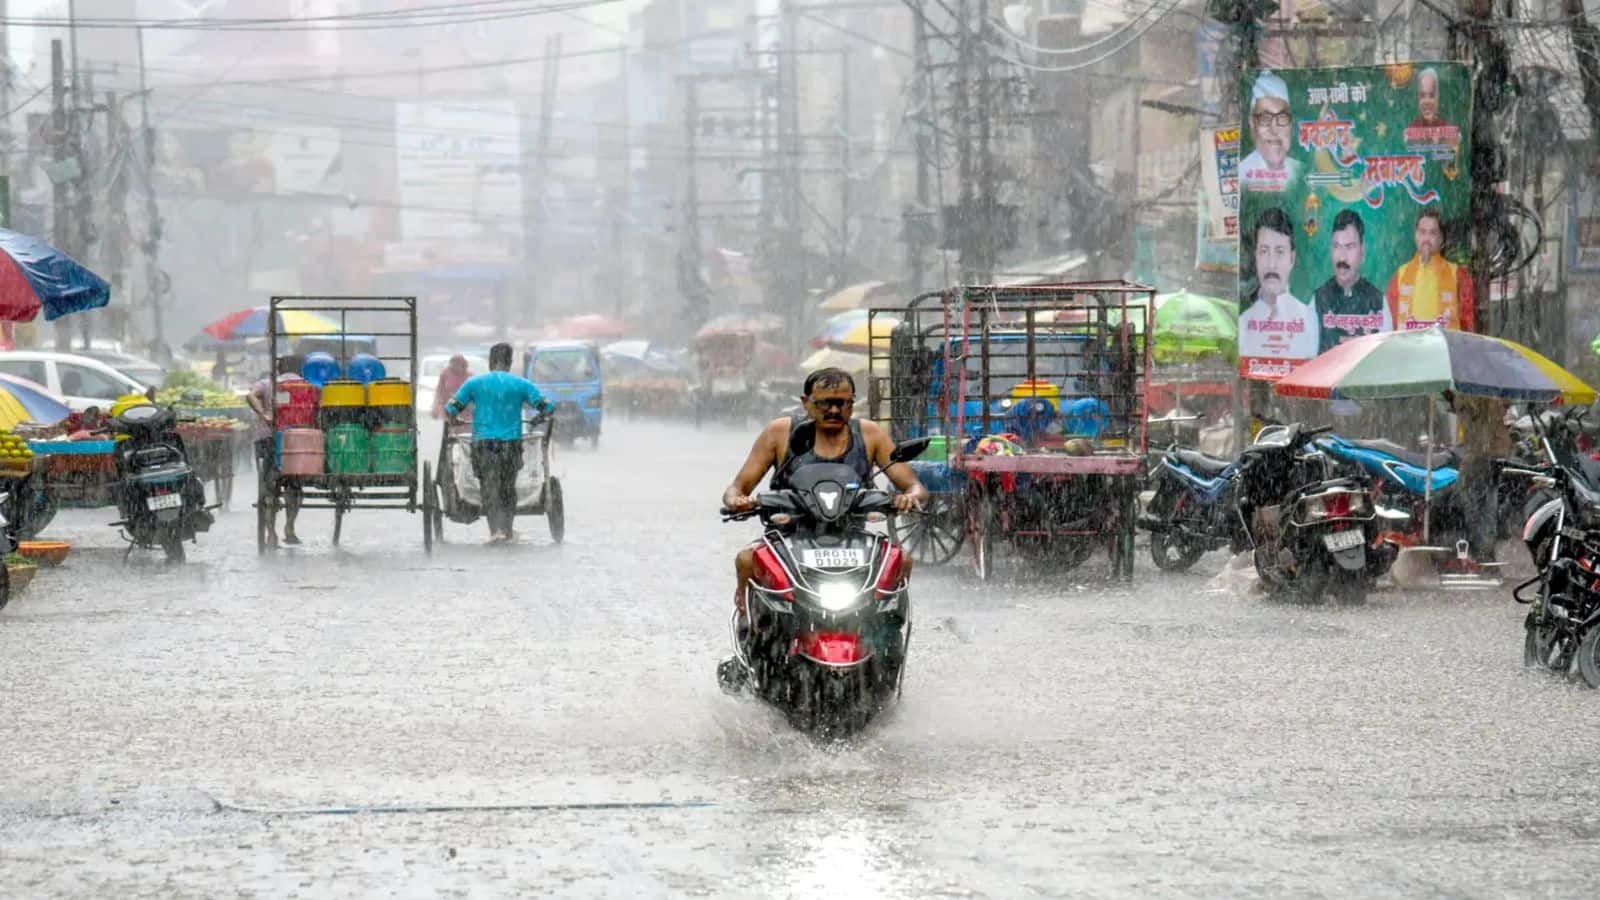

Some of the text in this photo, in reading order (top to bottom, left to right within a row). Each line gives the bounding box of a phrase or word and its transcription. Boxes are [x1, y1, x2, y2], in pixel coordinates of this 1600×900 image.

[1307, 82, 1368, 105] आप सभी को
